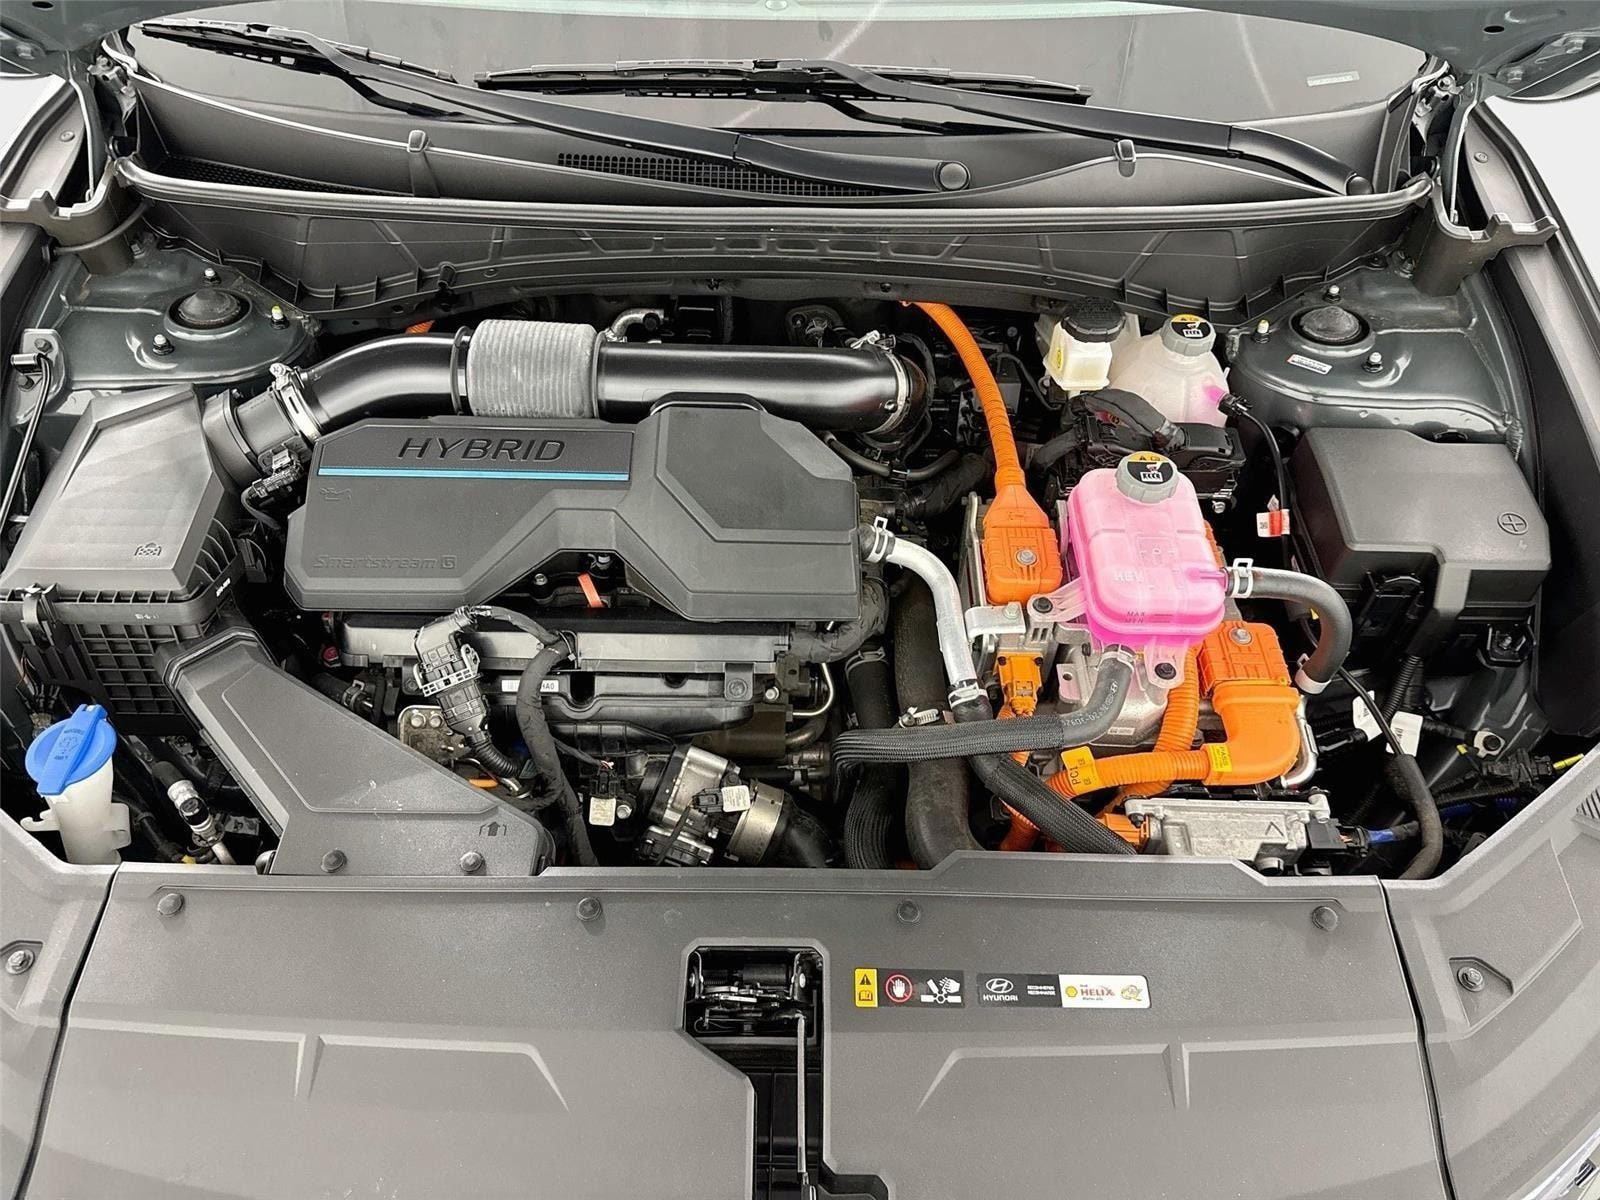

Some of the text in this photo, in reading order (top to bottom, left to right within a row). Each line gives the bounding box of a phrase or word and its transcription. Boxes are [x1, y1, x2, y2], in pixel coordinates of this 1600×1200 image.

[397, 438, 567, 462] HYBRID
[313, 555, 438, 569] Smartstream
[983, 994, 1018, 1002] HYUNDAI
[1081, 987, 1115, 997] HELIX
